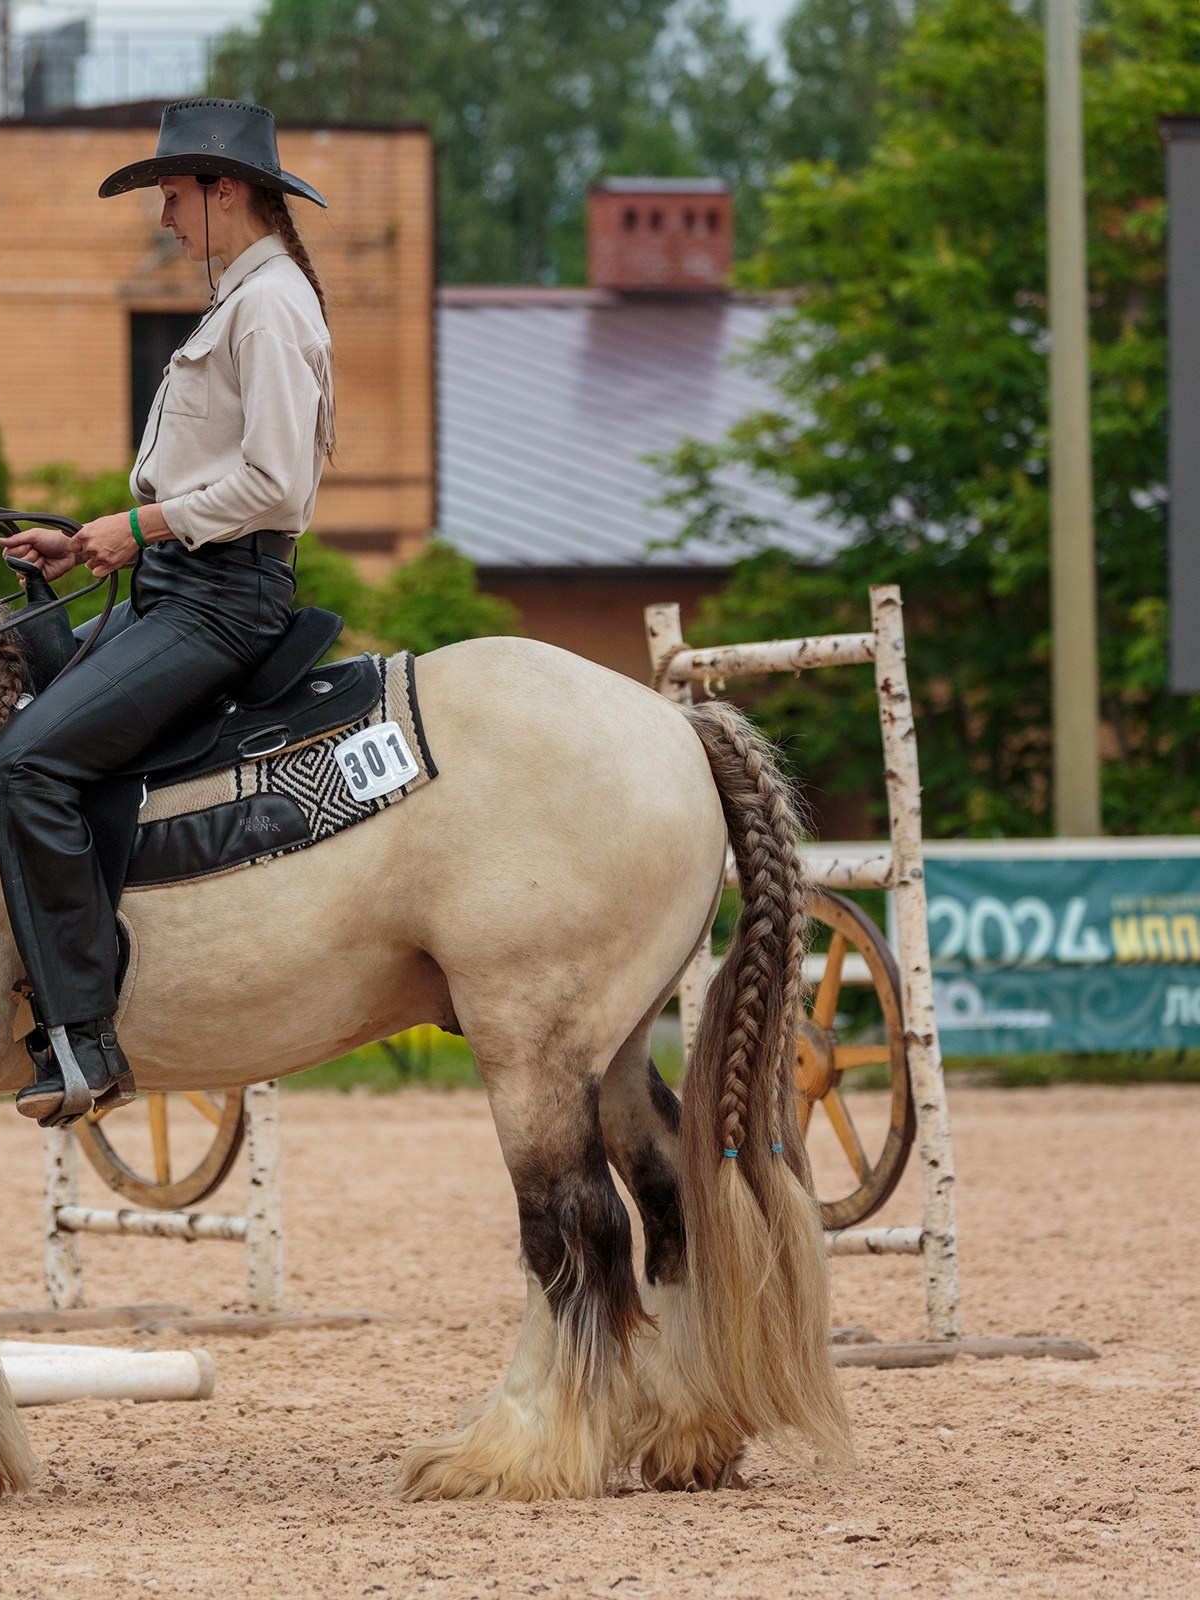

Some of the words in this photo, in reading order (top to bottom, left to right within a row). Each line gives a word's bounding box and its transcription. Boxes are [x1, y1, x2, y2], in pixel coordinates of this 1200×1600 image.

[344, 732, 409, 790] 301
[240, 815, 270, 827] BRAD
[926, 895, 1110, 964] 2024
